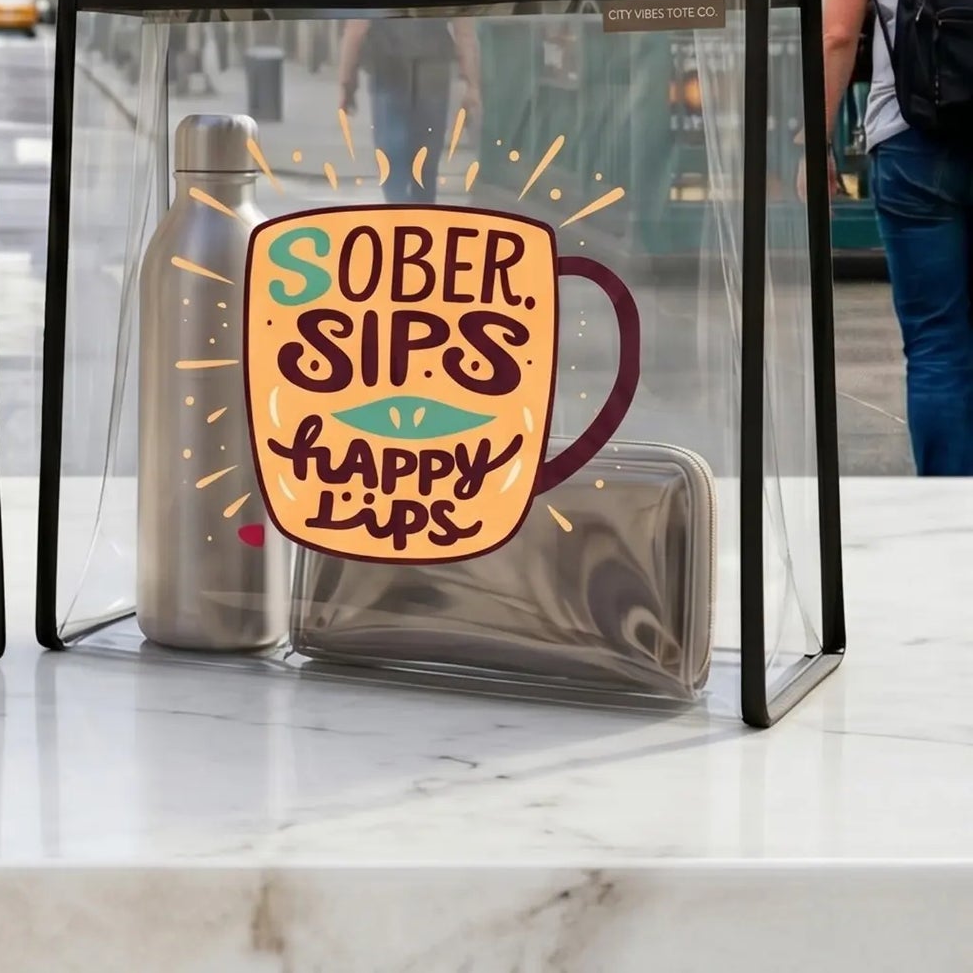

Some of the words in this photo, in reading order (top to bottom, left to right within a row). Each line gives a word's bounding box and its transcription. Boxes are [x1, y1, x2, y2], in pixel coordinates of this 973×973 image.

[608, 9, 633, 20] CITY
[634, 8, 664, 19] VIBES
[667, 7, 695, 18] TOTE
[696, 6, 718, 17] CO.
